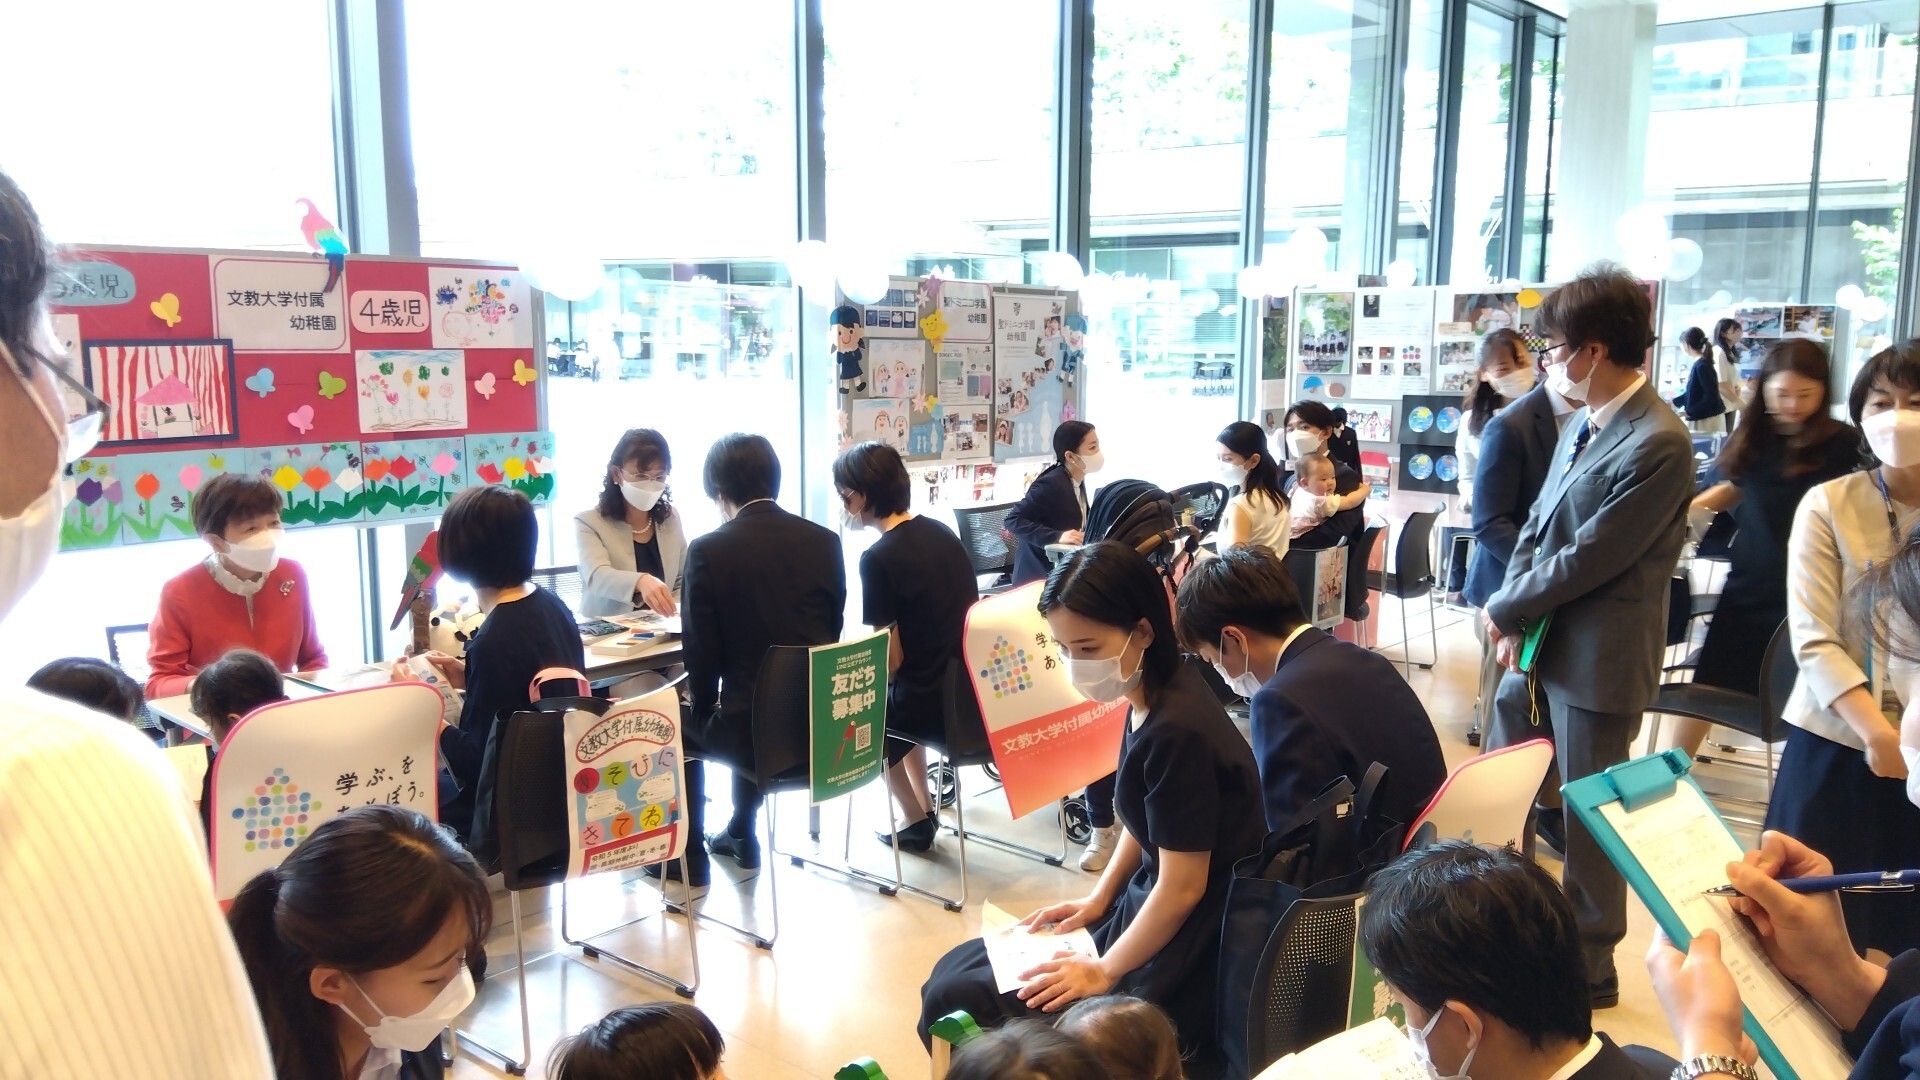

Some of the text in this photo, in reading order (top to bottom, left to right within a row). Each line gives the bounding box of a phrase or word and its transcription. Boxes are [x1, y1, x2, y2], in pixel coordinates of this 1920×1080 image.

[227, 289, 325, 308] 文教大学付属
[359, 297, 425, 328] 4歳児
[289, 314, 337, 331] 幼稚園
[831, 665, 876, 696] 友だち
[832, 689, 876, 721] 募集中
[579, 716, 673, 759] 文教大学付属幼稚園
